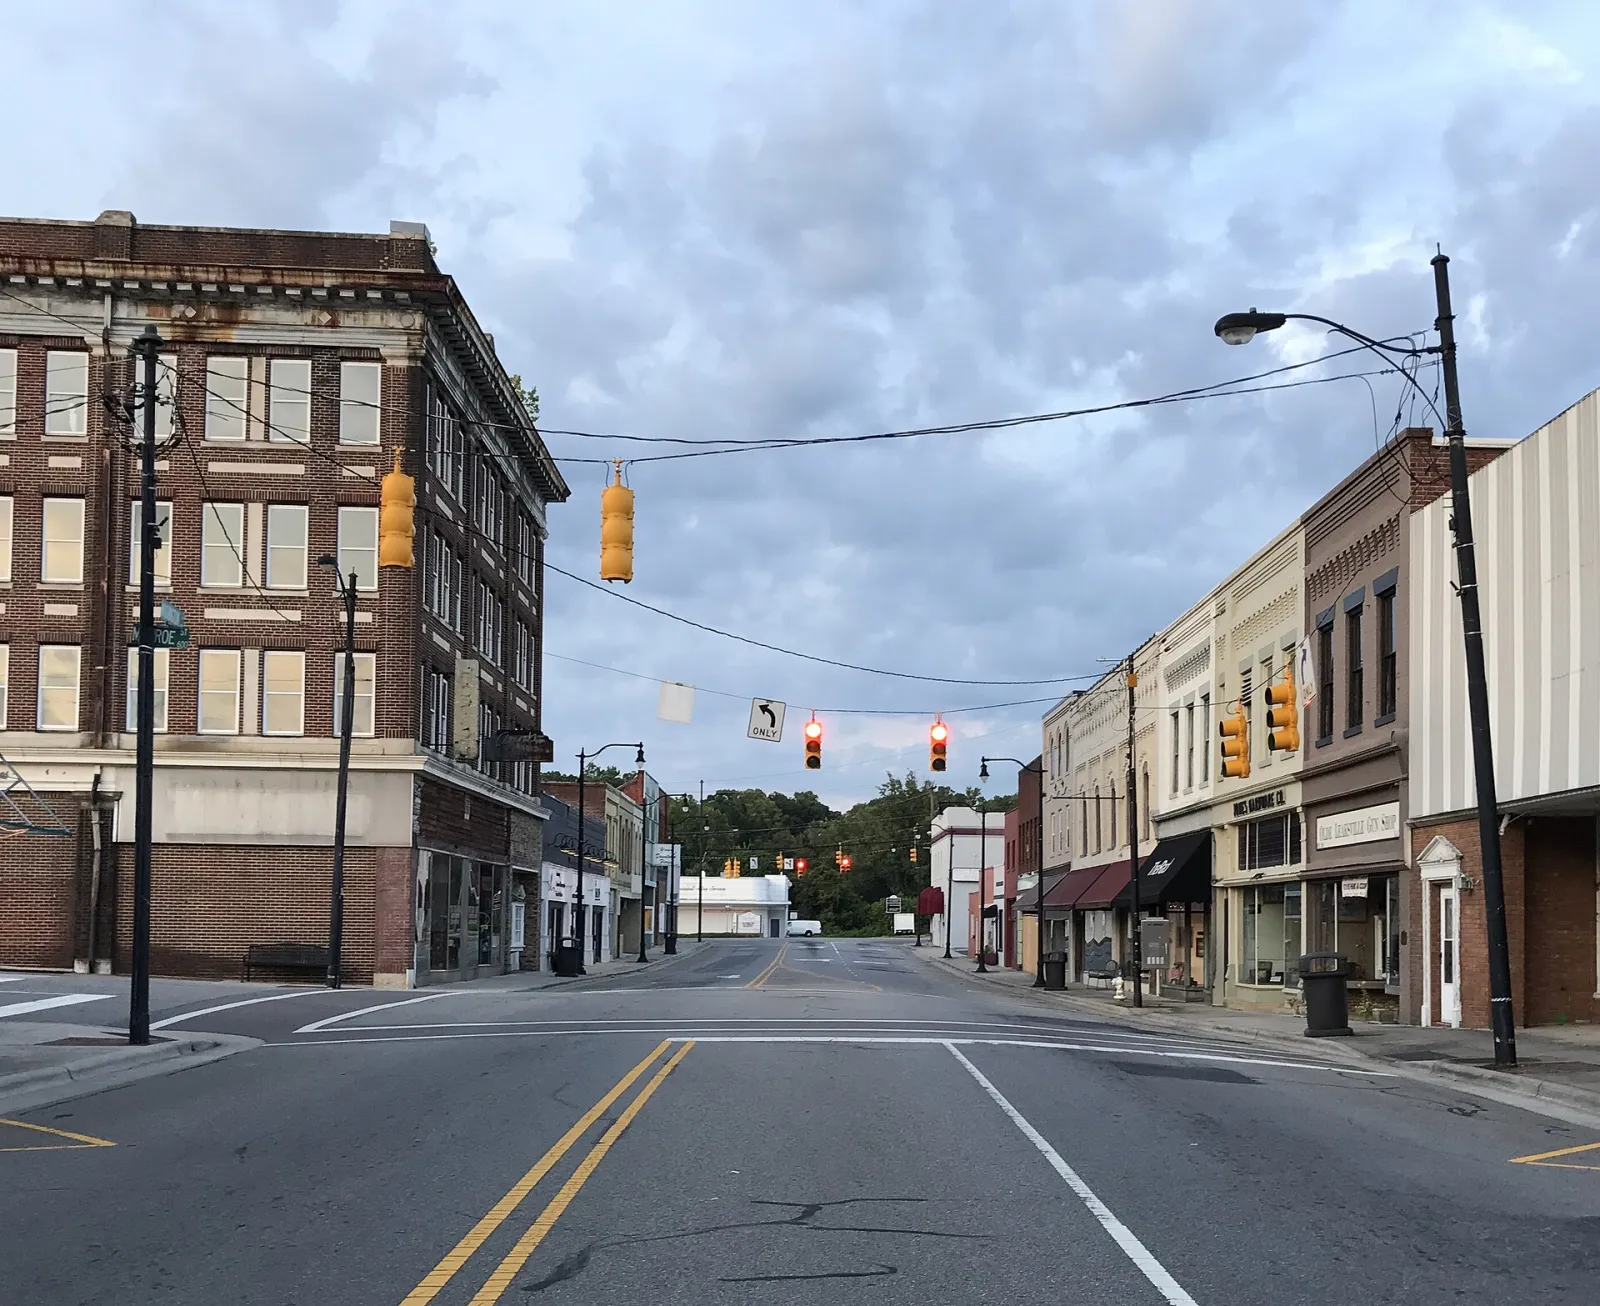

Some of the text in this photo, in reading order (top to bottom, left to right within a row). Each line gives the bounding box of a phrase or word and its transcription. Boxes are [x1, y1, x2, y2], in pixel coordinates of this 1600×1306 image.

[132, 626, 188, 645] MROE ST
[177, 640, 188, 648] 600
[752, 727, 777, 738] ONLY
